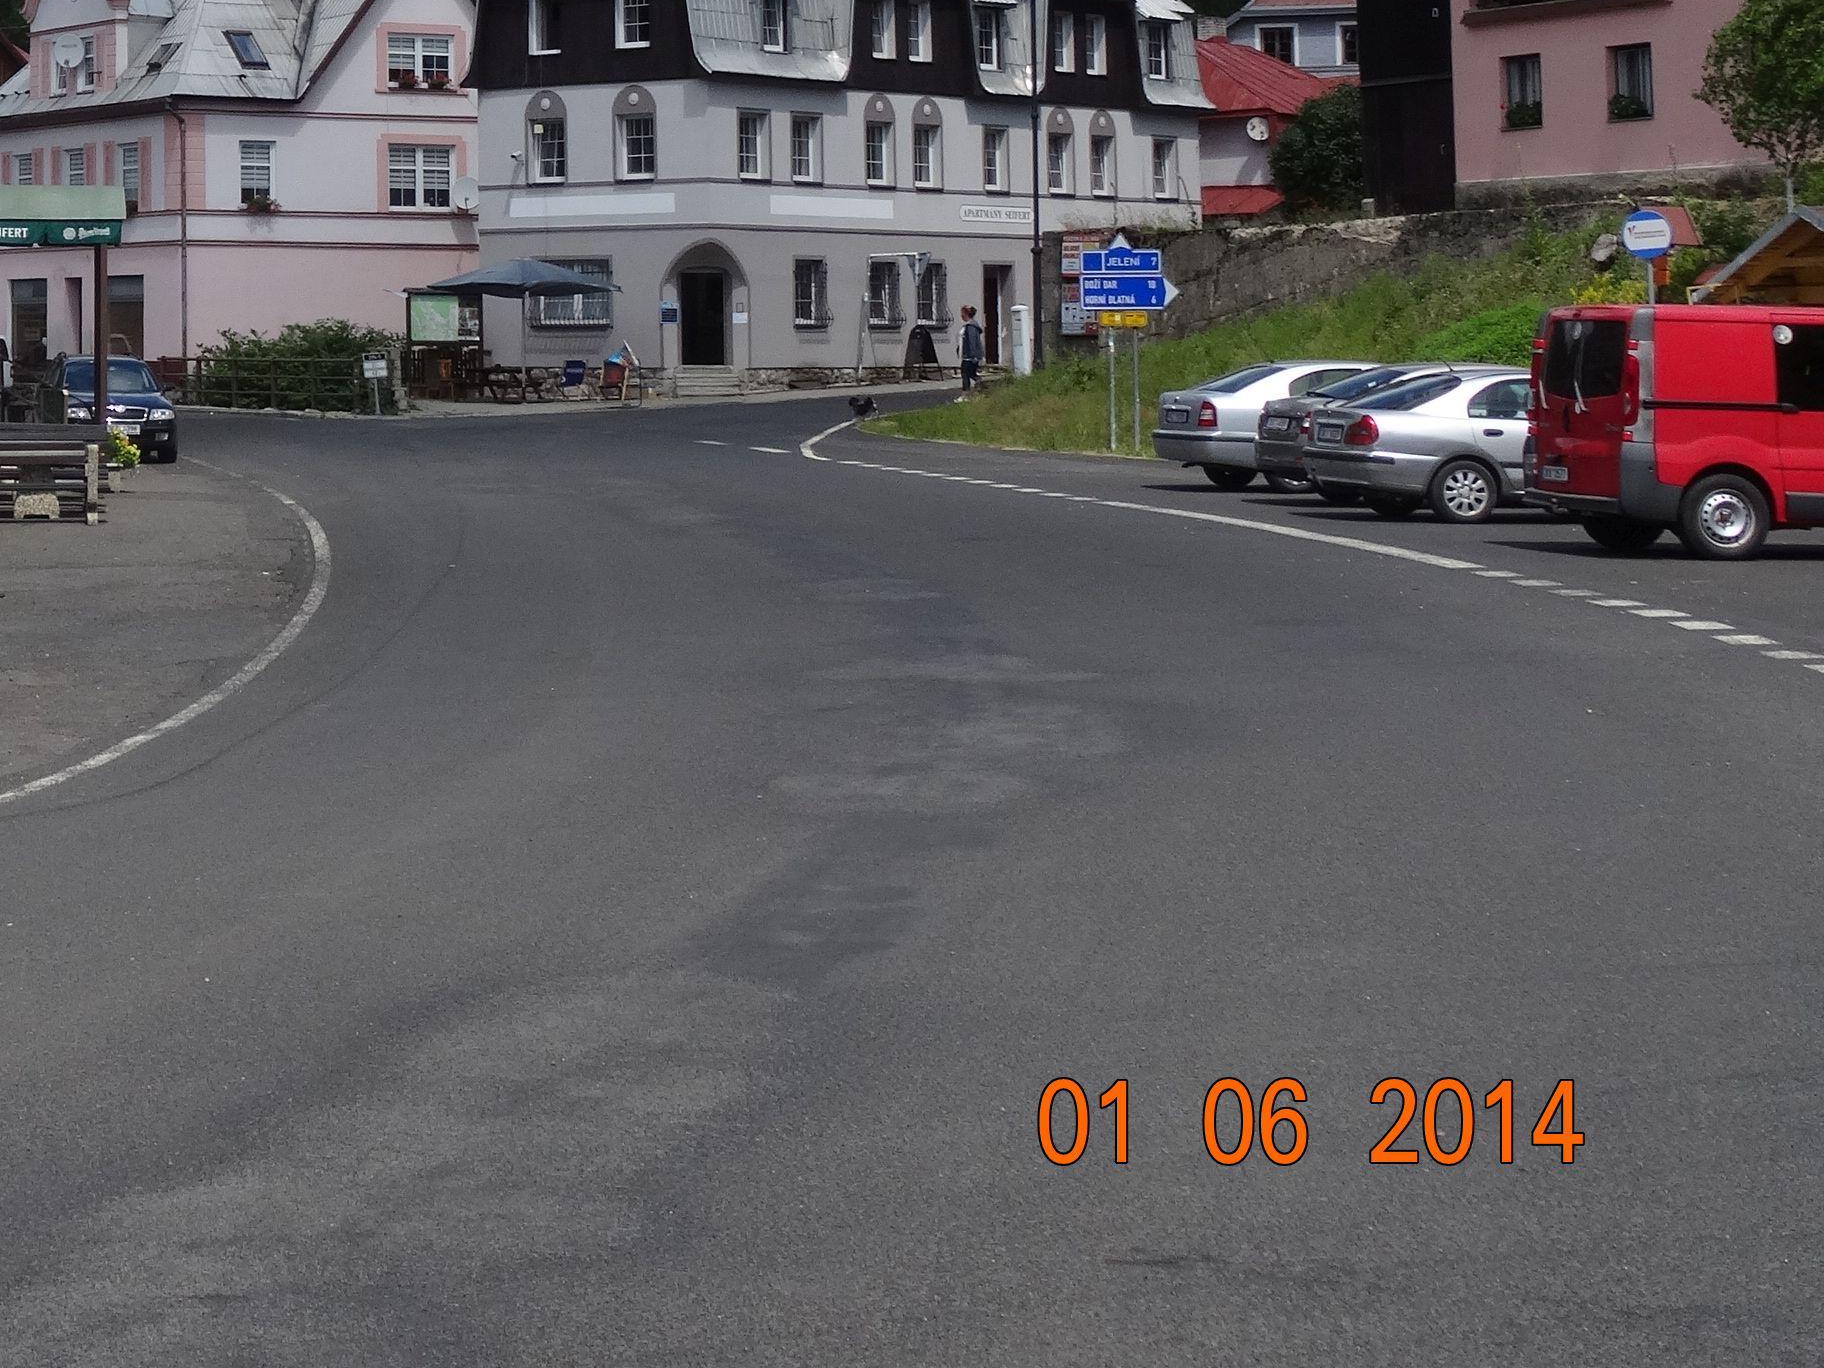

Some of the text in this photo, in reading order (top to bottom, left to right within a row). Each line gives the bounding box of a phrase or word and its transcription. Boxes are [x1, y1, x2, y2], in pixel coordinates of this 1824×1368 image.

[1004, 211, 1031, 220] SEIFERT
[1106, 256, 1157, 266] JELENÍ 7
[1108, 294, 1135, 304] BLATNÁ
